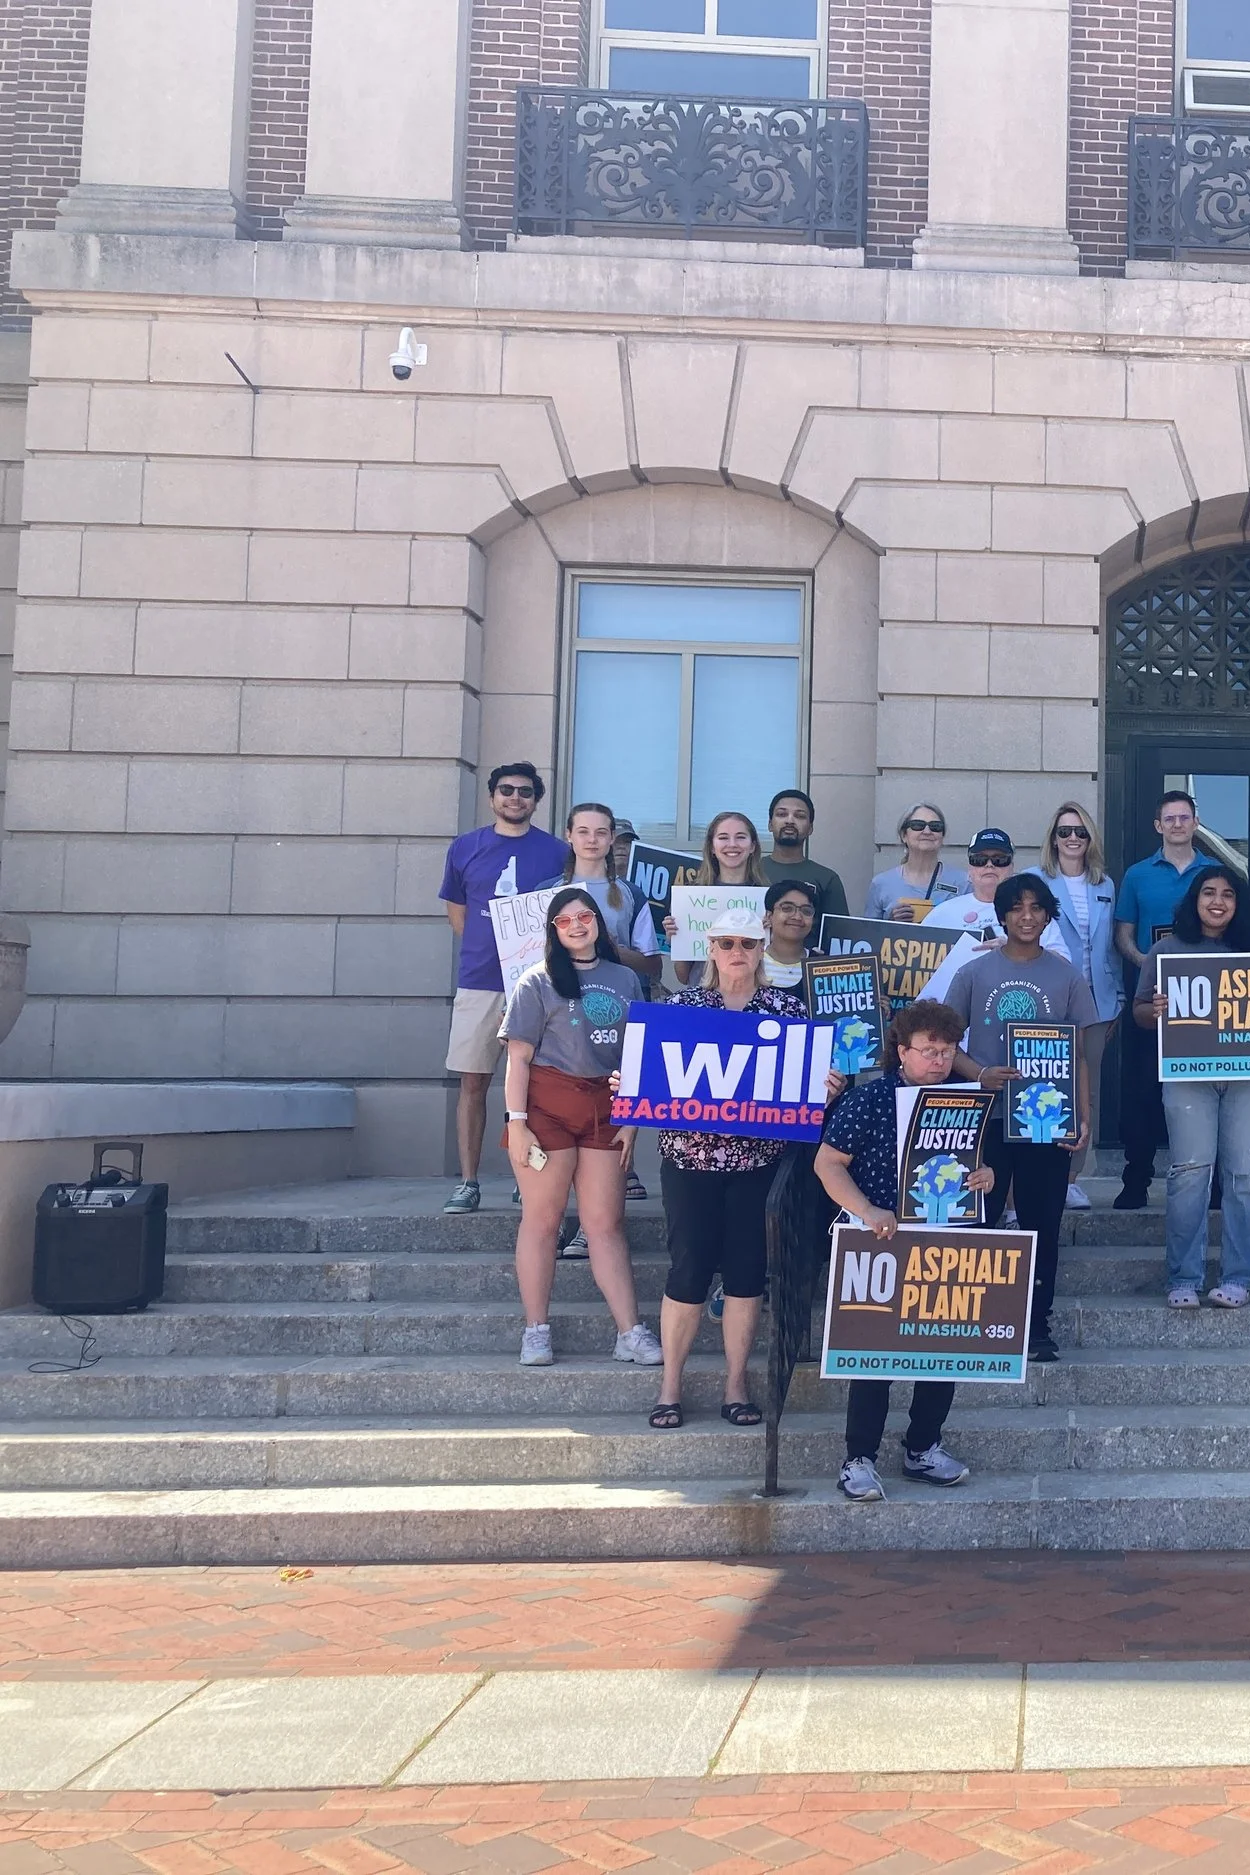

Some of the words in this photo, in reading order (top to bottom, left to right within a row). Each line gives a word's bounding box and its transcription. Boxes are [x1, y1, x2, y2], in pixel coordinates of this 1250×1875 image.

[635, 861, 670, 900] NO
[496, 890, 559, 940] FOSS
[688, 894, 717, 911] We
[727, 896, 757, 913] only
[688, 913, 713, 932] hav
[881, 937, 956, 970] ASPHA
[814, 966, 836, 974] PEOPLE
[882, 967, 935, 998] LAN
[814, 972, 873, 996] CLIMATE
[1167, 975, 1212, 1018] NO
[816, 991, 875, 1016] JUSTICE
[985, 988, 998, 1011] YOUTH
[1000, 980, 1042, 994] ORGANIZING
[1041, 995, 1051, 1014] TEAM
[1014, 1039, 1070, 1059] CLIMATE
[1218, 1032, 1232, 1043] IN
[618, 1022, 646, 1097] I
[661, 1019, 835, 1104] will
[1170, 1063, 1187, 1072] DO
[1189, 1062, 1213, 1072] NOT
[611, 1097, 825, 1126] #ActOnClimate
[920, 1108, 983, 1129] CLIMATE
[914, 1128, 978, 1150] JUSTICE
[840, 1251, 898, 1303] NO
[904, 1246, 1022, 1284] ASPHALT
[900, 1284, 987, 1321] PLANT
[899, 1322, 915, 1336] IN
[918, 1322, 982, 1338] NASHUA
[836, 1356, 857, 1369] DO
[860, 1357, 890, 1370] NOT
[892, 1358, 954, 1371] POLLUTE
[957, 1359, 985, 1372] OUR
[987, 1360, 1011, 1373] AIR
